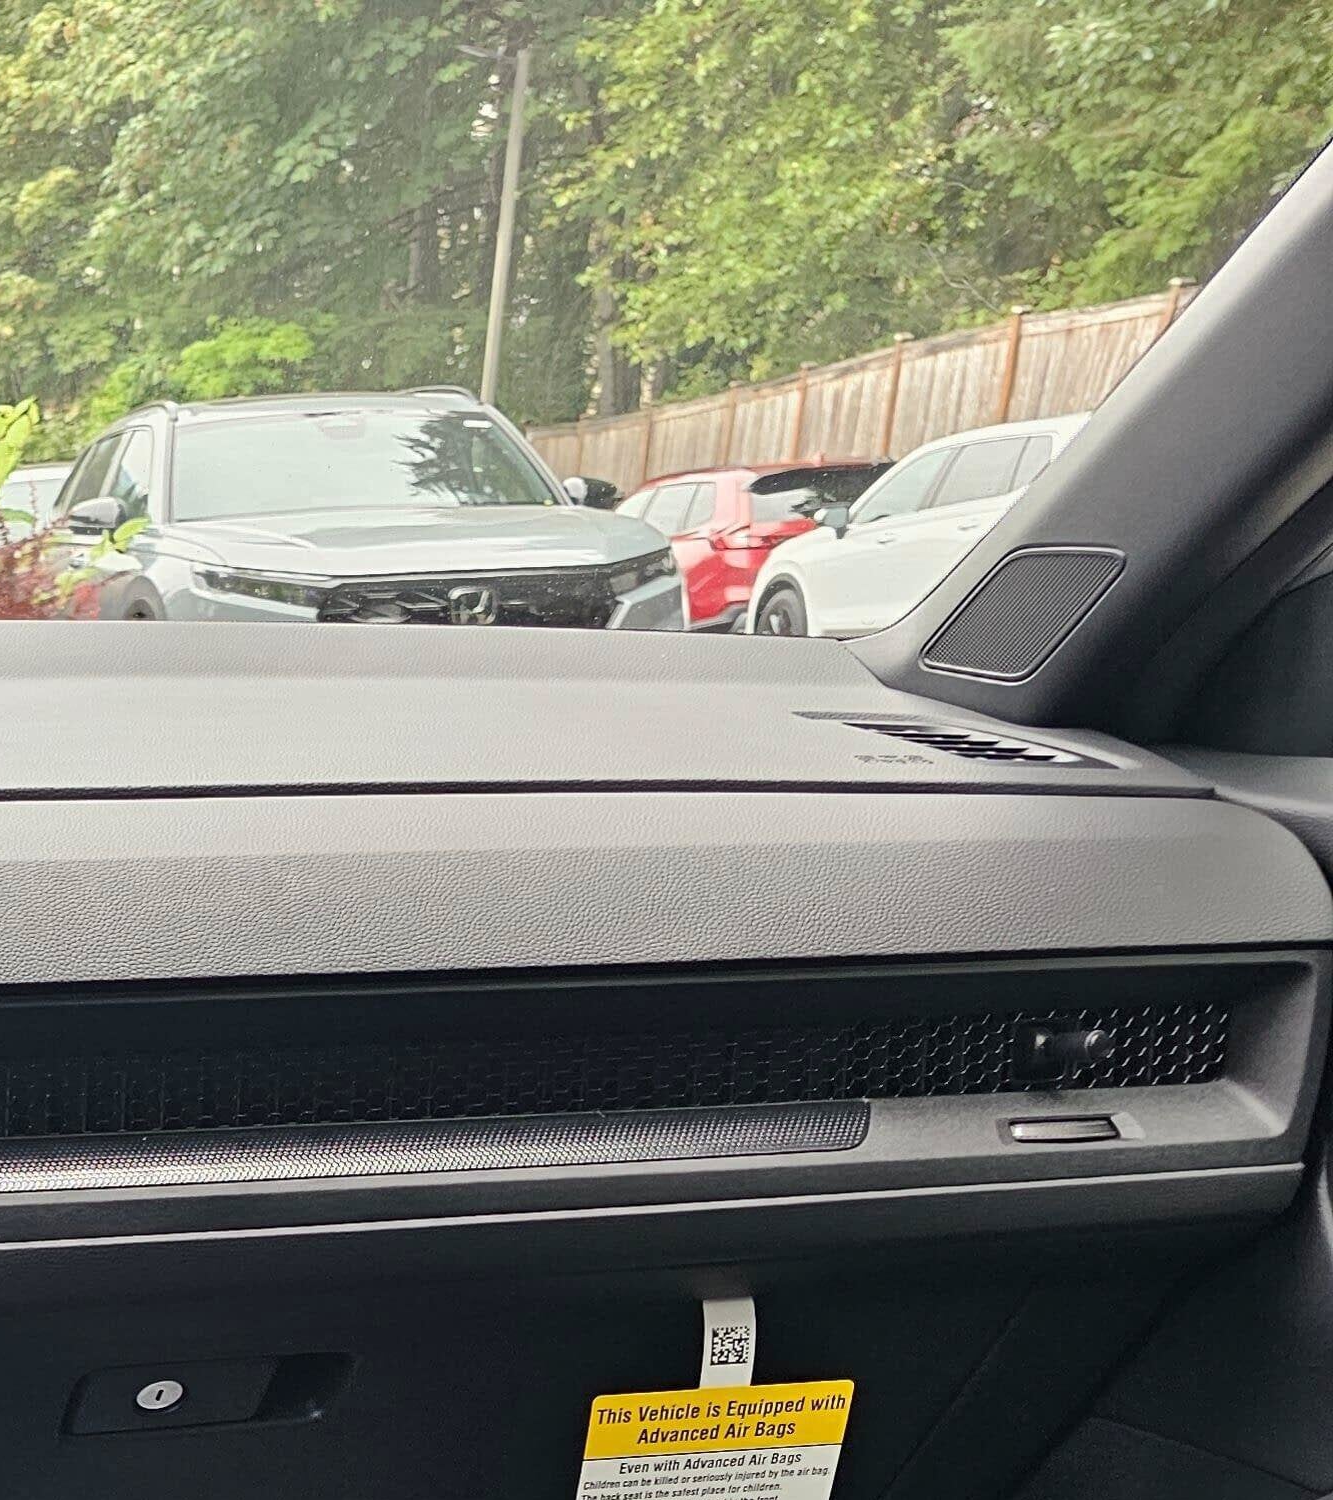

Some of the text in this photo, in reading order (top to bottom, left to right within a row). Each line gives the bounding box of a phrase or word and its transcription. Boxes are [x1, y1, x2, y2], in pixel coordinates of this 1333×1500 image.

[597, 1394, 846, 1425] This Vehicle is Equipped with
[636, 1421, 796, 1444] Advanced Air Bags
[619, 1452, 802, 1475] Even with Advanced Air Bags
[583, 1480, 621, 1490] Children
[622, 1480, 638, 1488] can
[641, 1478, 652, 1487] be
[654, 1476, 679, 1485] killed
[681, 1476, 691, 1484] or
[692, 1471, 732, 1483] seriously
[735, 1470, 766, 1480] injured
[768, 1468, 778, 1479] by
[781, 1468, 794, 1477] the
[797, 1467, 809, 1476] air
[623, 1492, 642, 1500] seat
[645, 1490, 653, 1499] is
[655, 1490, 670, 1499] the
[672, 1488, 699, 1498] safest
[701, 1487, 725, 1497] place
[728, 1485, 741, 1494] for
[743, 1483, 783, 1493] children.
